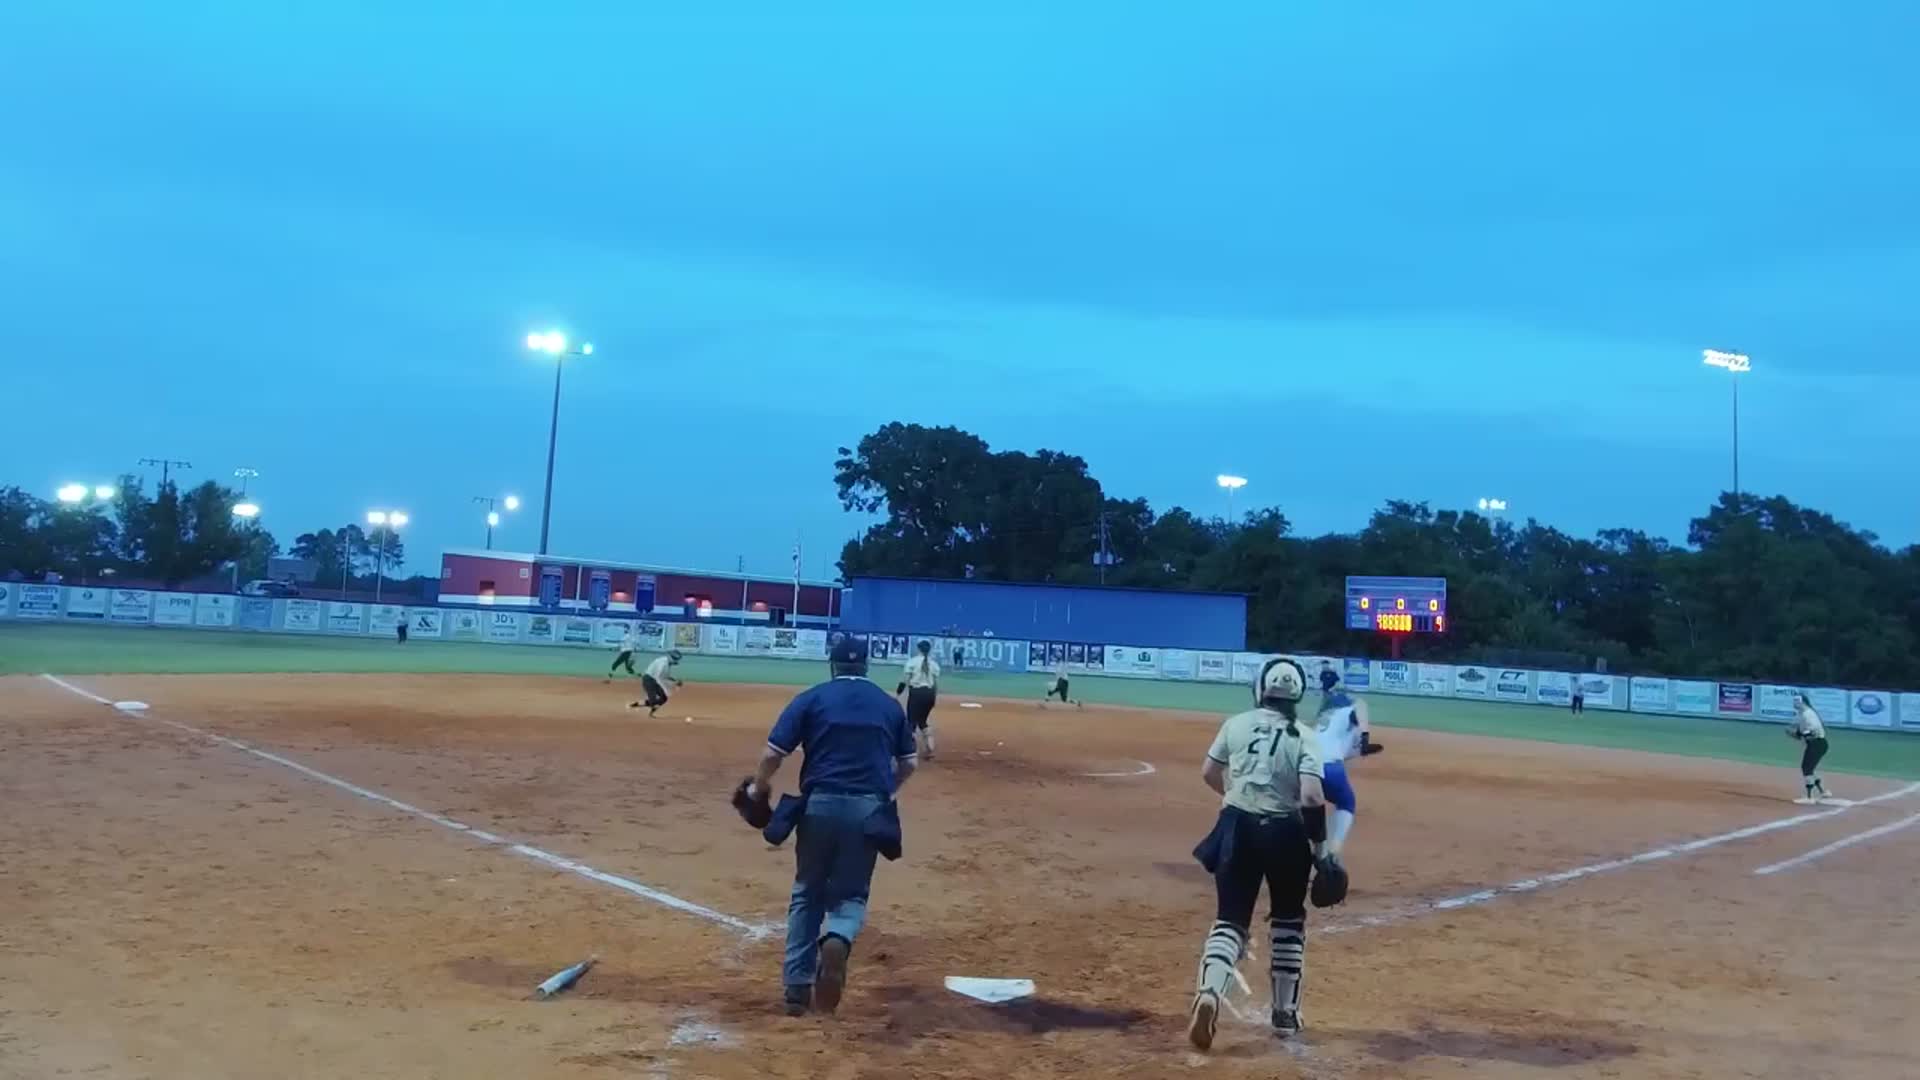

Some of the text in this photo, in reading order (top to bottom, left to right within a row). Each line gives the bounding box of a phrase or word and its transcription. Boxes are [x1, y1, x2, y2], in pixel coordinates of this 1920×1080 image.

[1361, 597, 1369, 609] 0
[1397, 598, 1405, 610] 0
[1429, 599, 1438, 611] 0
